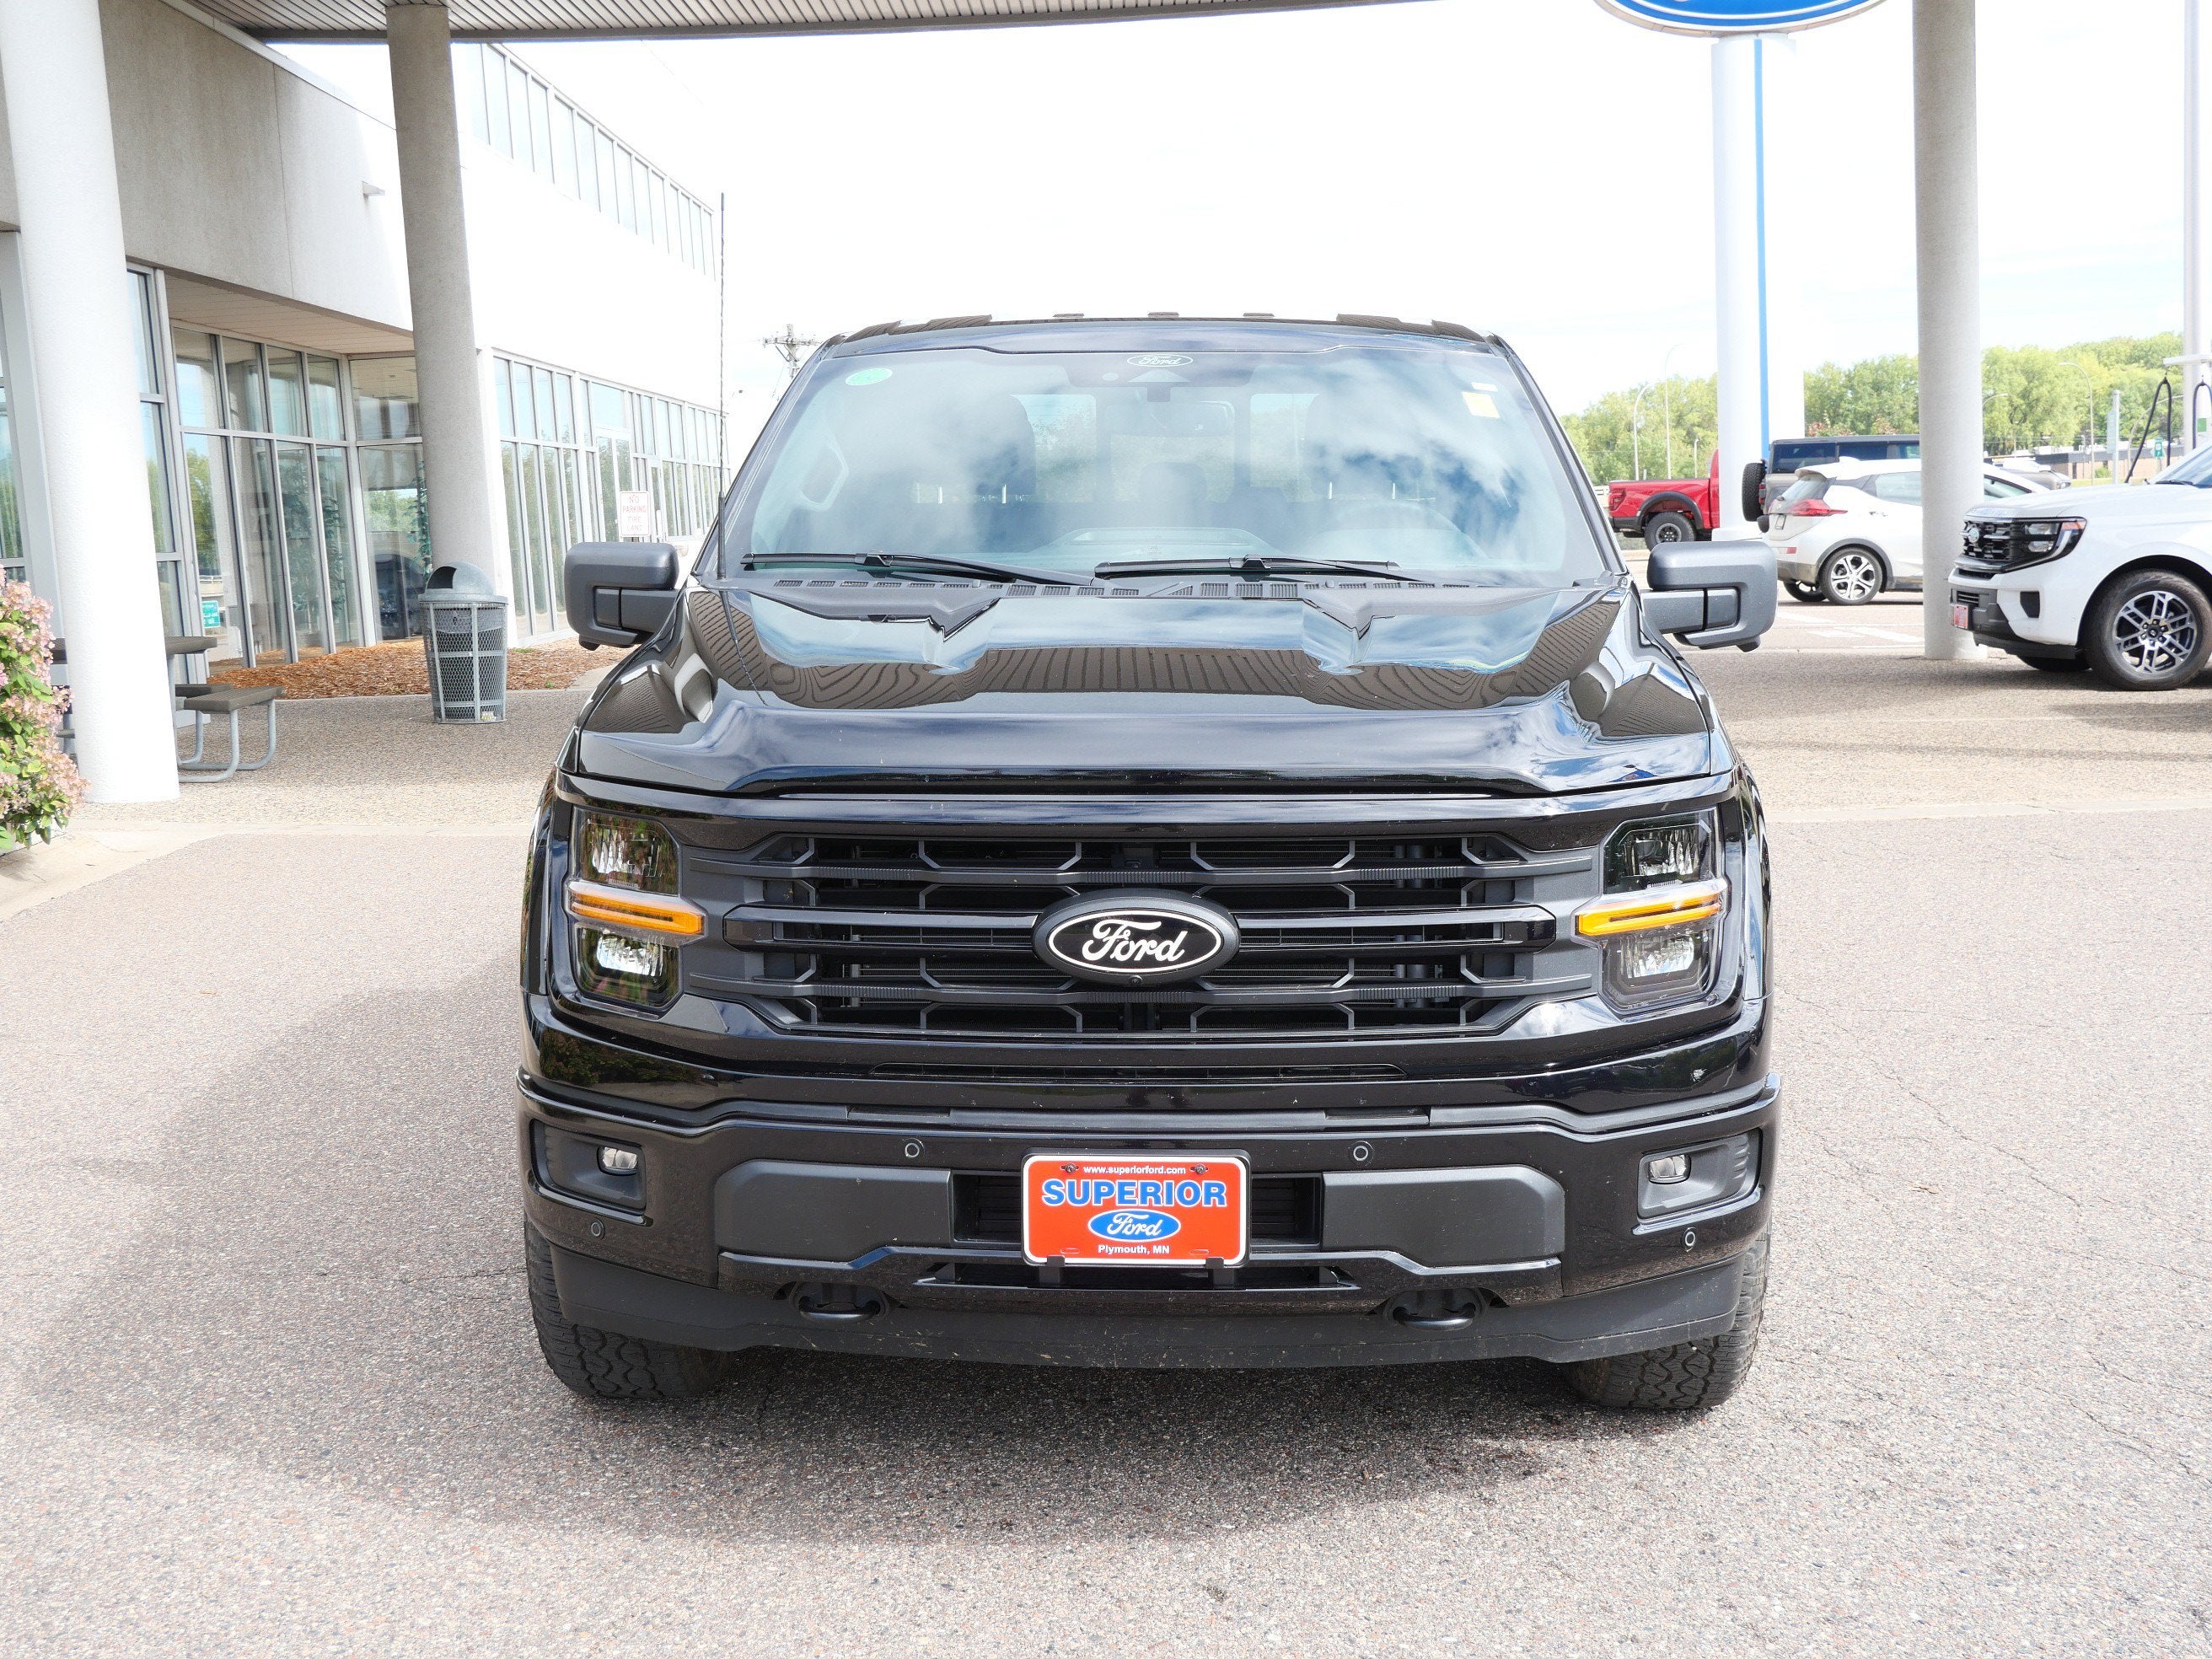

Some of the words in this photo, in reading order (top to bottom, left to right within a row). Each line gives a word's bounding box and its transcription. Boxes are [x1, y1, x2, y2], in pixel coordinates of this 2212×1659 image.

[1138, 356, 1182, 365] Ford
[629, 496, 640, 504] NO
[1082, 919, 1189, 962] Ford
[1083, 1166, 1186, 1176] www.superiorford.com
[1042, 1178, 1227, 1207] SUPERIOR
[1106, 1212, 1163, 1236] Ford
[1098, 1244, 1151, 1255] Plymouth,
[1152, 1245, 1170, 1254] MN
